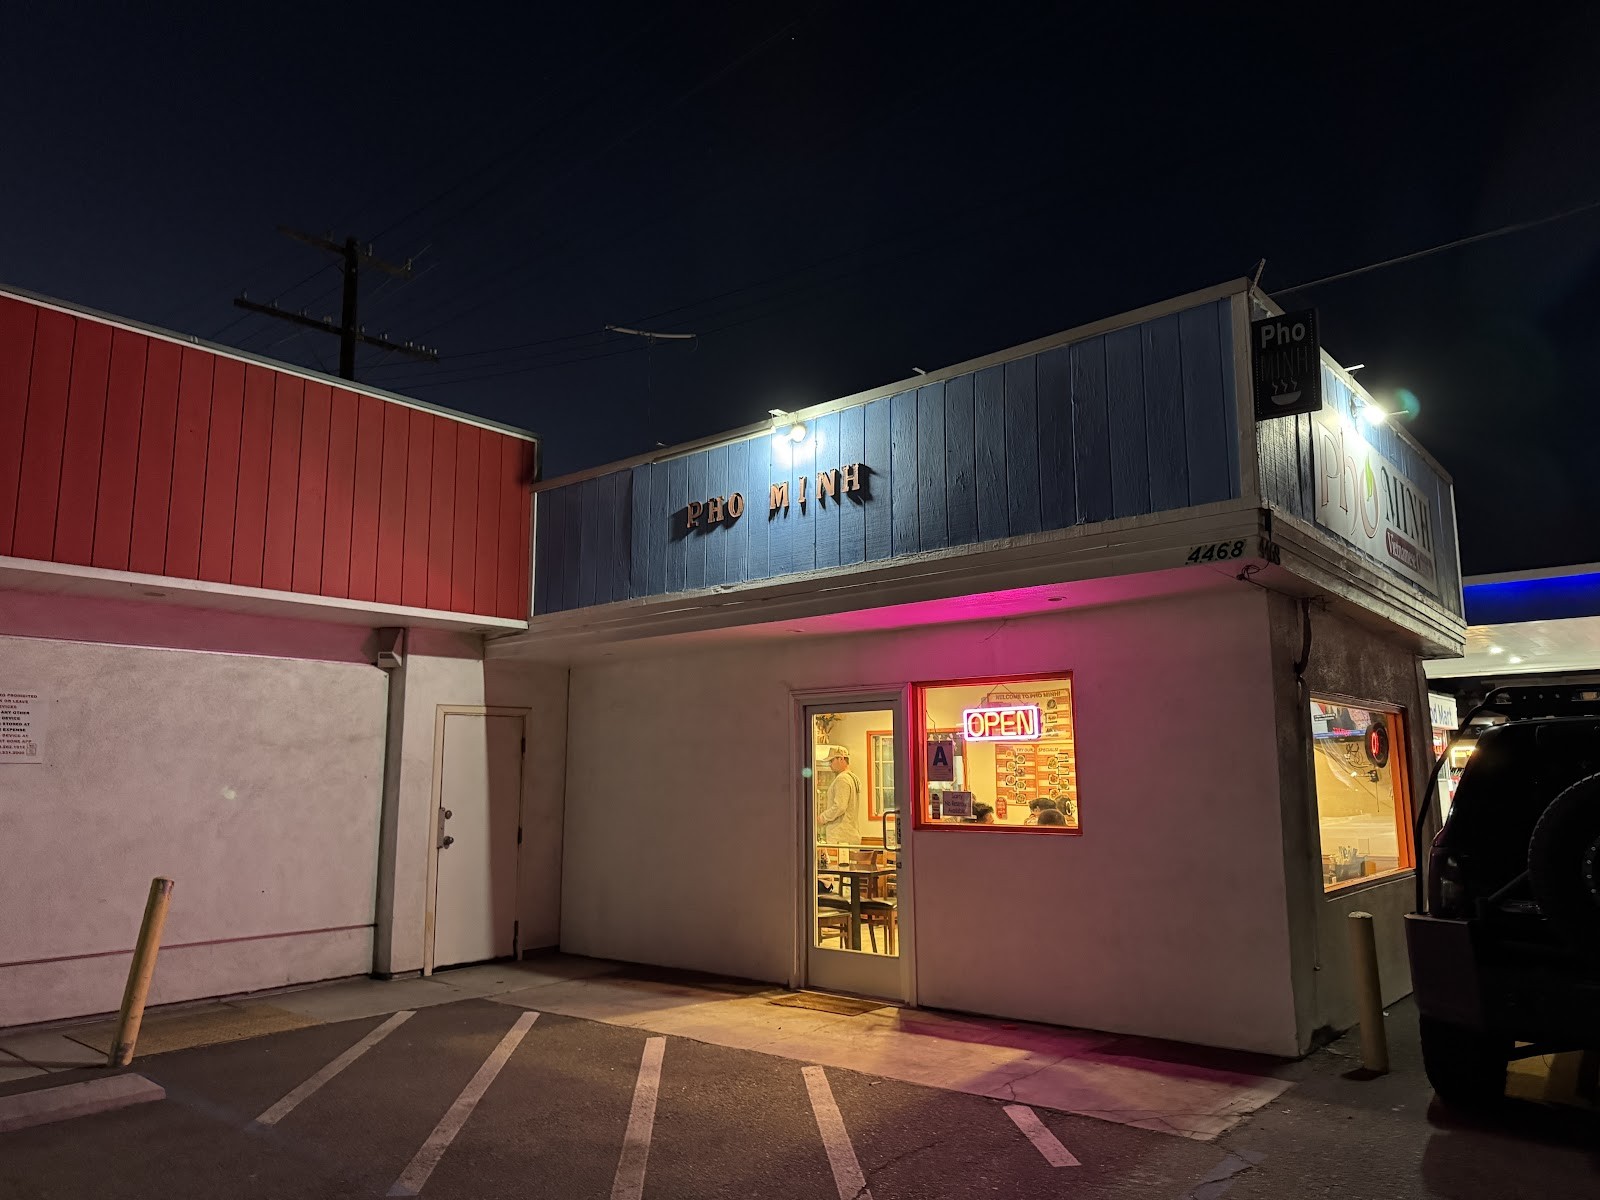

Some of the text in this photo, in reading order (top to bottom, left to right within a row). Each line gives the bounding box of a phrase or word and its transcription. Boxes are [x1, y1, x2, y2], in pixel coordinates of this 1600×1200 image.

[1260, 322, 1306, 349] Pho
[687, 463, 860, 528] PHO MINH
[1187, 540, 1245, 562] 4468
[967, 709, 1034, 738] OPEN
[932, 745, 948, 766] A
